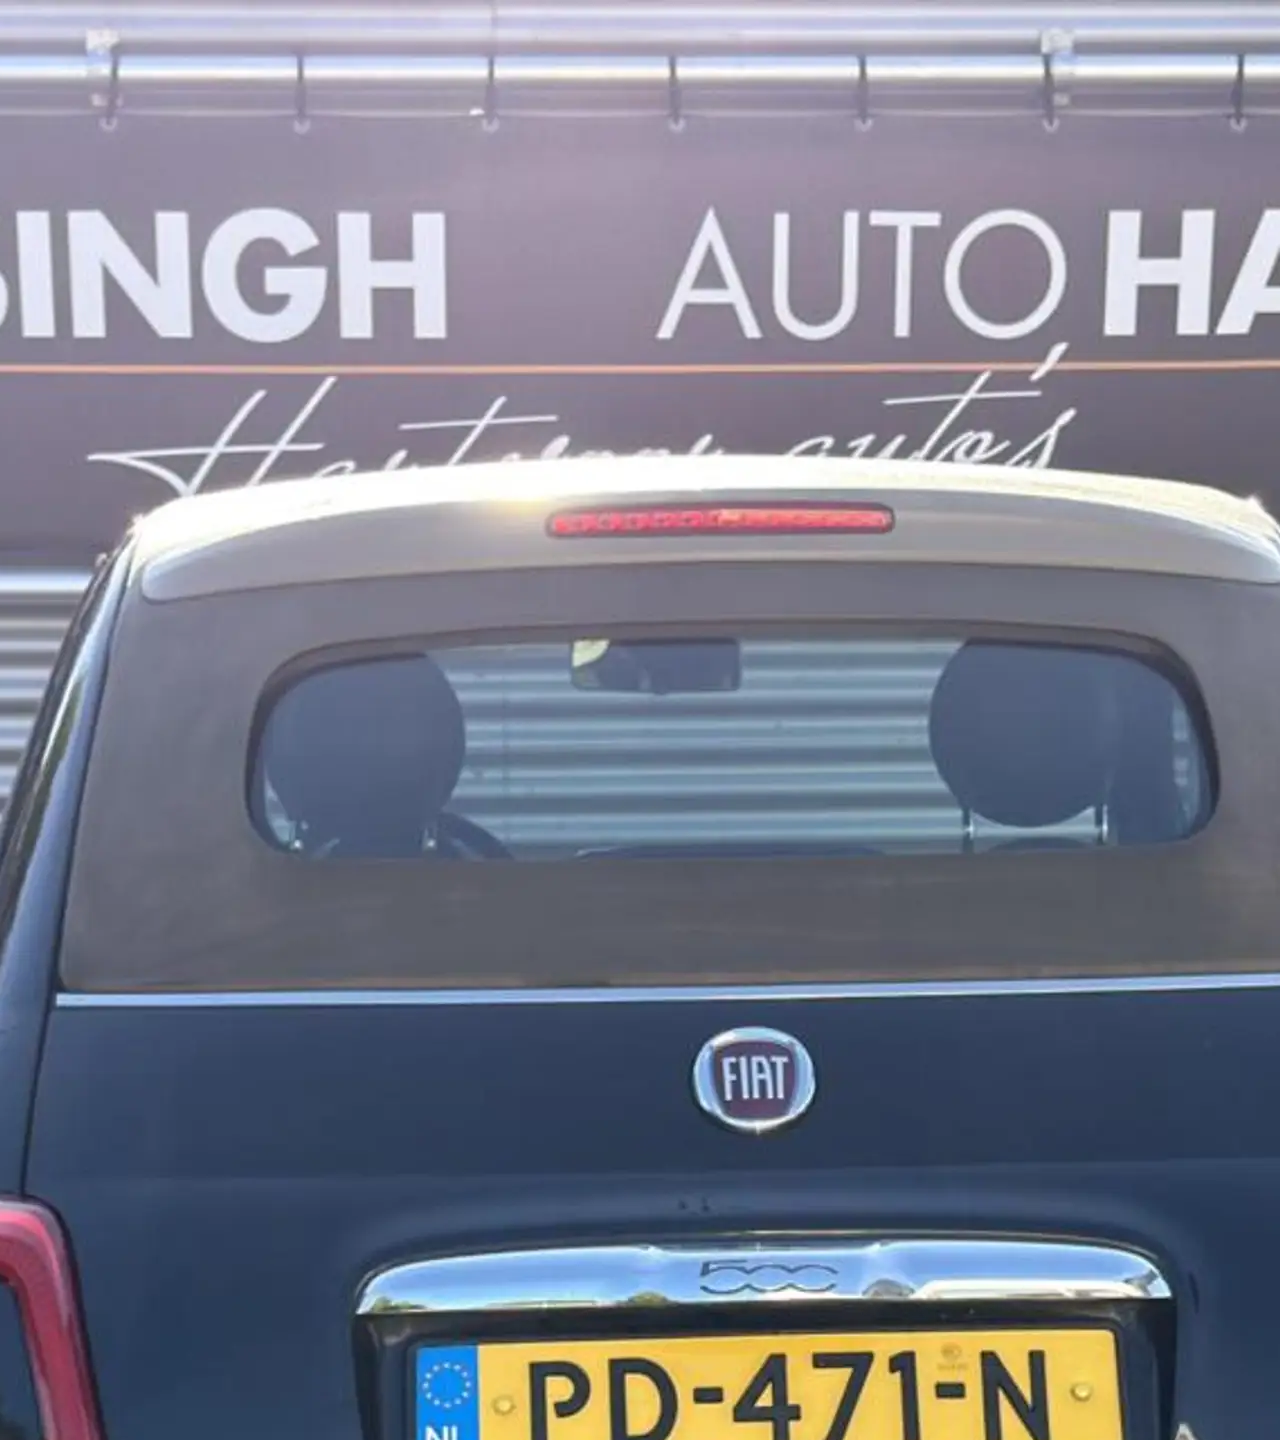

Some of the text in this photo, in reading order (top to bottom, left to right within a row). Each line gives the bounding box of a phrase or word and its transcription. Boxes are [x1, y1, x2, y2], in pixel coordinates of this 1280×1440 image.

[656, 206, 1067, 341] AUTO
[722, 1055, 789, 1101] FIAT
[700, 1259, 839, 1295] 500
